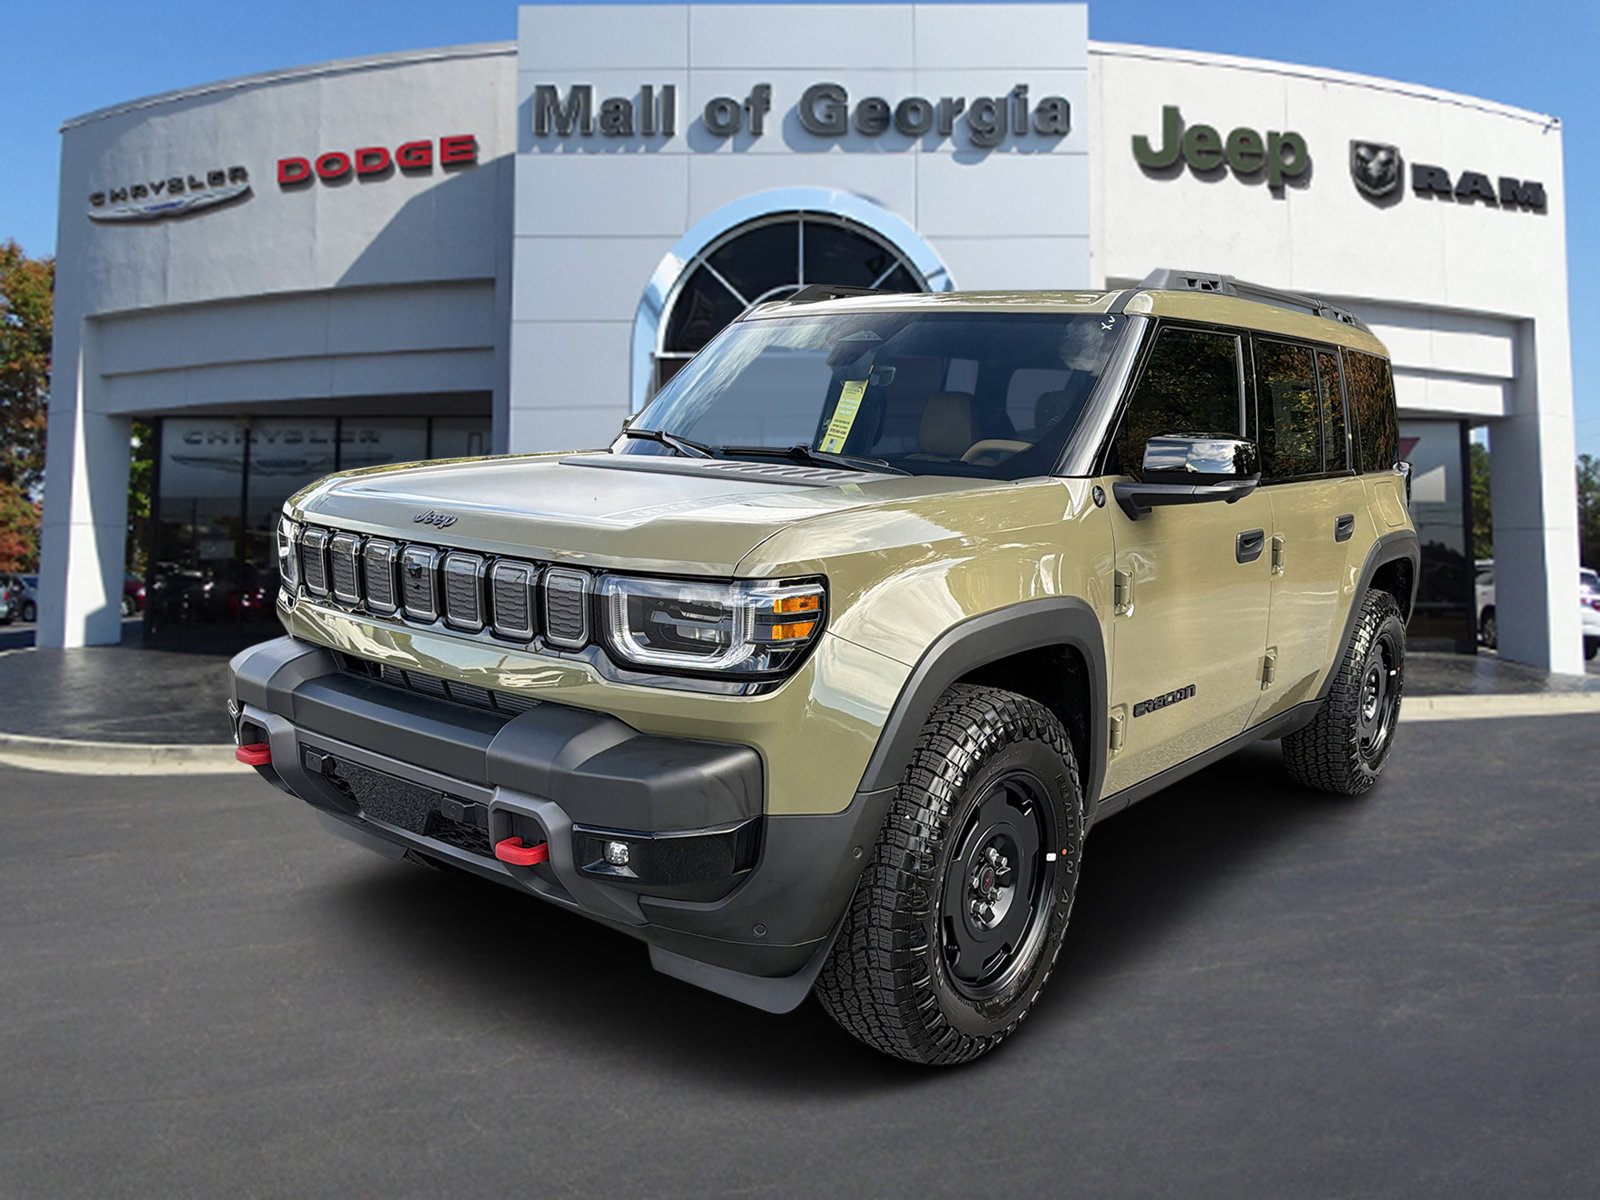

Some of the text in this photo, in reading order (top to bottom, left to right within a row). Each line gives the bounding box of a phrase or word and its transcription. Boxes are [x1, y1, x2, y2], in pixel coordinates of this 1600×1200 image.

[533, 83, 1071, 148] Mall of Georgia
[277, 134, 475, 186] DODGE
[1132, 105, 1309, 188] Jeep
[89, 166, 249, 207] CHRYSLER
[1411, 162, 1546, 211] RAM
[413, 509, 458, 530] Jeep
